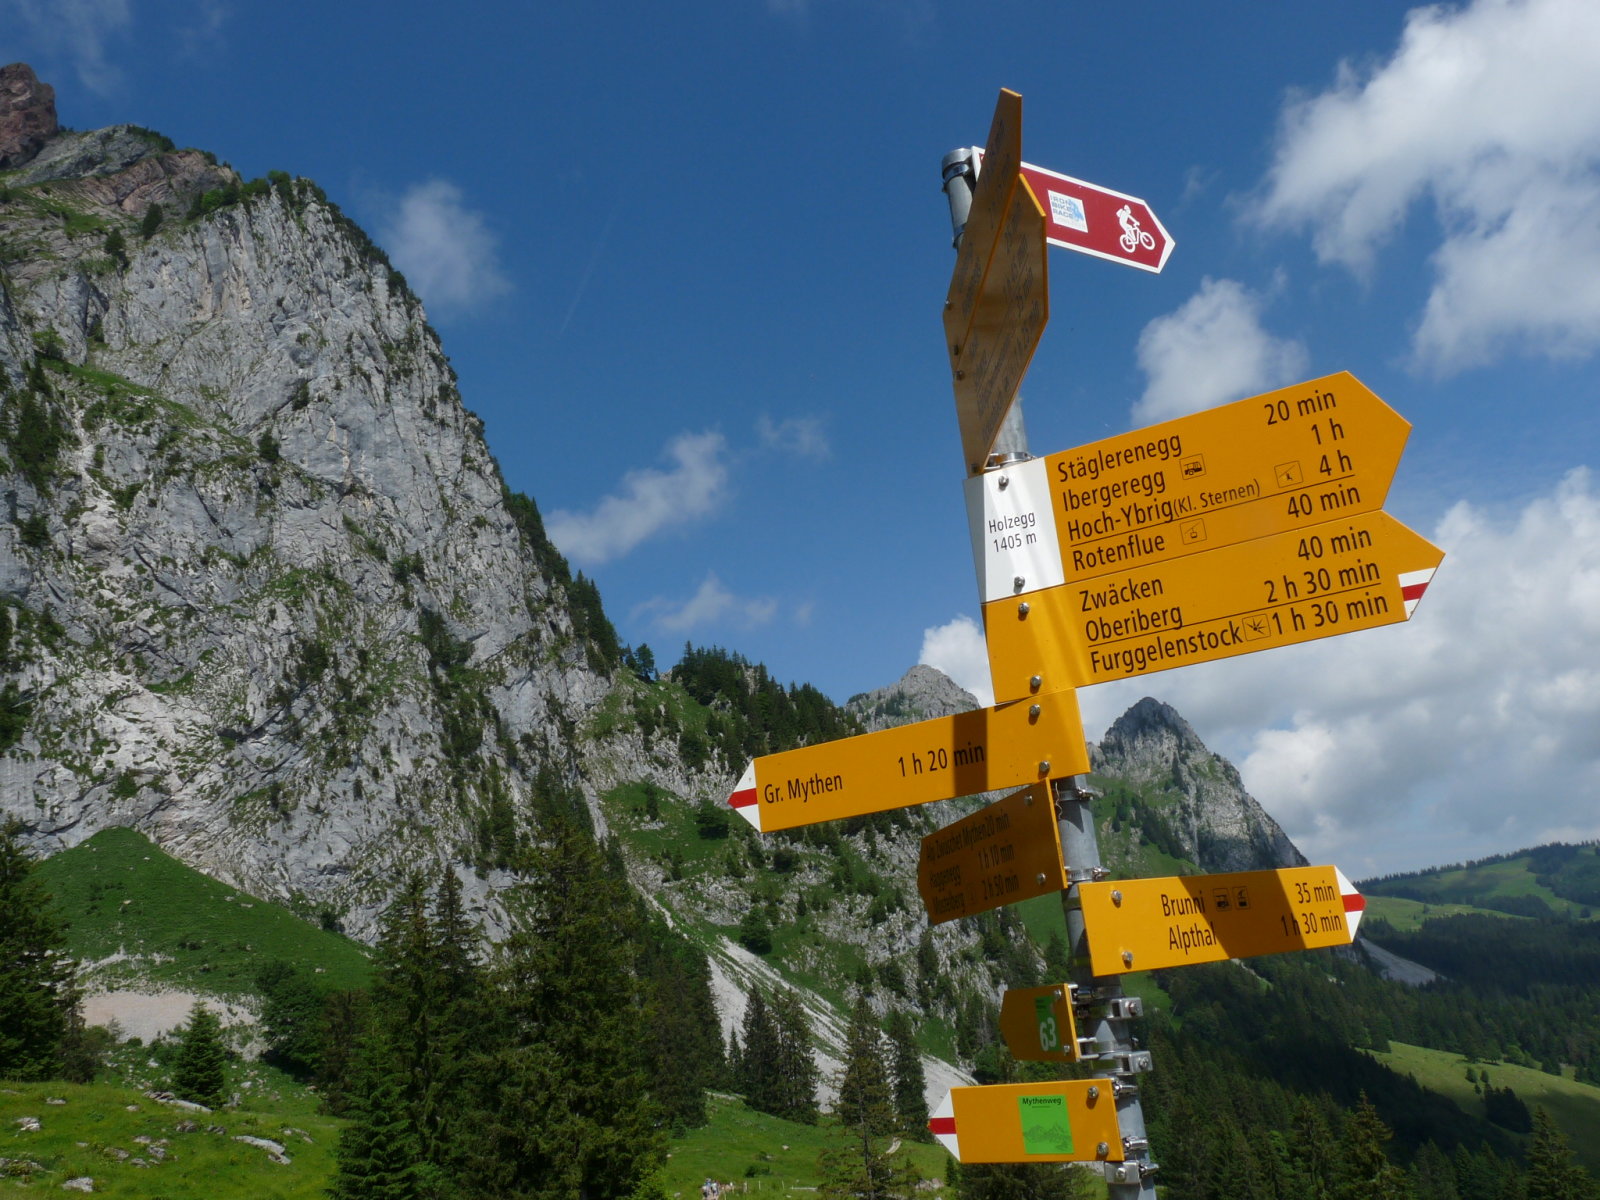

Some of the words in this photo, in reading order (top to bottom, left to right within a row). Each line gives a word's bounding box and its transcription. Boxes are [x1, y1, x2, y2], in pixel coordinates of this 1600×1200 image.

[1057, 433, 1183, 482] Stäglerenegg
[1264, 400, 1290, 425] 20
[1298, 389, 1337, 418] min
[1062, 469, 1166, 512] Ibergeregg
[1311, 424, 1322, 446] 1
[1331, 418, 1345, 440] h
[1199, 478, 1261, 509] Sternen)
[1319, 455, 1332, 477] 4
[1339, 450, 1353, 472] h
[988, 512, 1036, 534] Holzegg
[993, 533, 1022, 553] 1405
[1026, 533, 1037, 545] m
[1072, 532, 1165, 572] Rotenflue
[1287, 493, 1313, 519] 40
[1320, 484, 1360, 512] min
[1079, 576, 1163, 612] Zwäcken
[1297, 536, 1324, 561] 40
[1331, 527, 1372, 555] min
[1085, 604, 1184, 642] Oberiberg
[1264, 580, 1277, 604] 2
[1284, 575, 1298, 599] h
[1305, 568, 1331, 594] 30
[1338, 560, 1381, 587] min
[1091, 621, 1244, 674] Furggelenstock
[1272, 613, 1284, 636] 1
[1291, 608, 1306, 631] h
[1312, 601, 1339, 627] 30
[1347, 593, 1388, 620] min
[764, 783, 784, 804] Gr.
[788, 773, 843, 803] Mythen
[898, 756, 906, 777] 1
[912, 754, 923, 775] h
[927, 748, 948, 772] 20
[953, 742, 985, 768] min
[996, 809, 1010, 832] min
[984, 848, 990, 868] h
[1000, 839, 1014, 864] min
[1004, 870, 1019, 894] min
[1160, 889, 1206, 917] Brunni
[1295, 882, 1311, 904] 35
[1313, 879, 1336, 903] min
[1169, 921, 1217, 955] Alpthal
[1282, 916, 1289, 936] 1
[1292, 914, 1300, 935] h
[1301, 912, 1318, 934] 30
[1320, 909, 1342, 933] min
[1039, 1017, 1056, 1052] 63
[1022, 1096, 1062, 1106] Mythenweg
